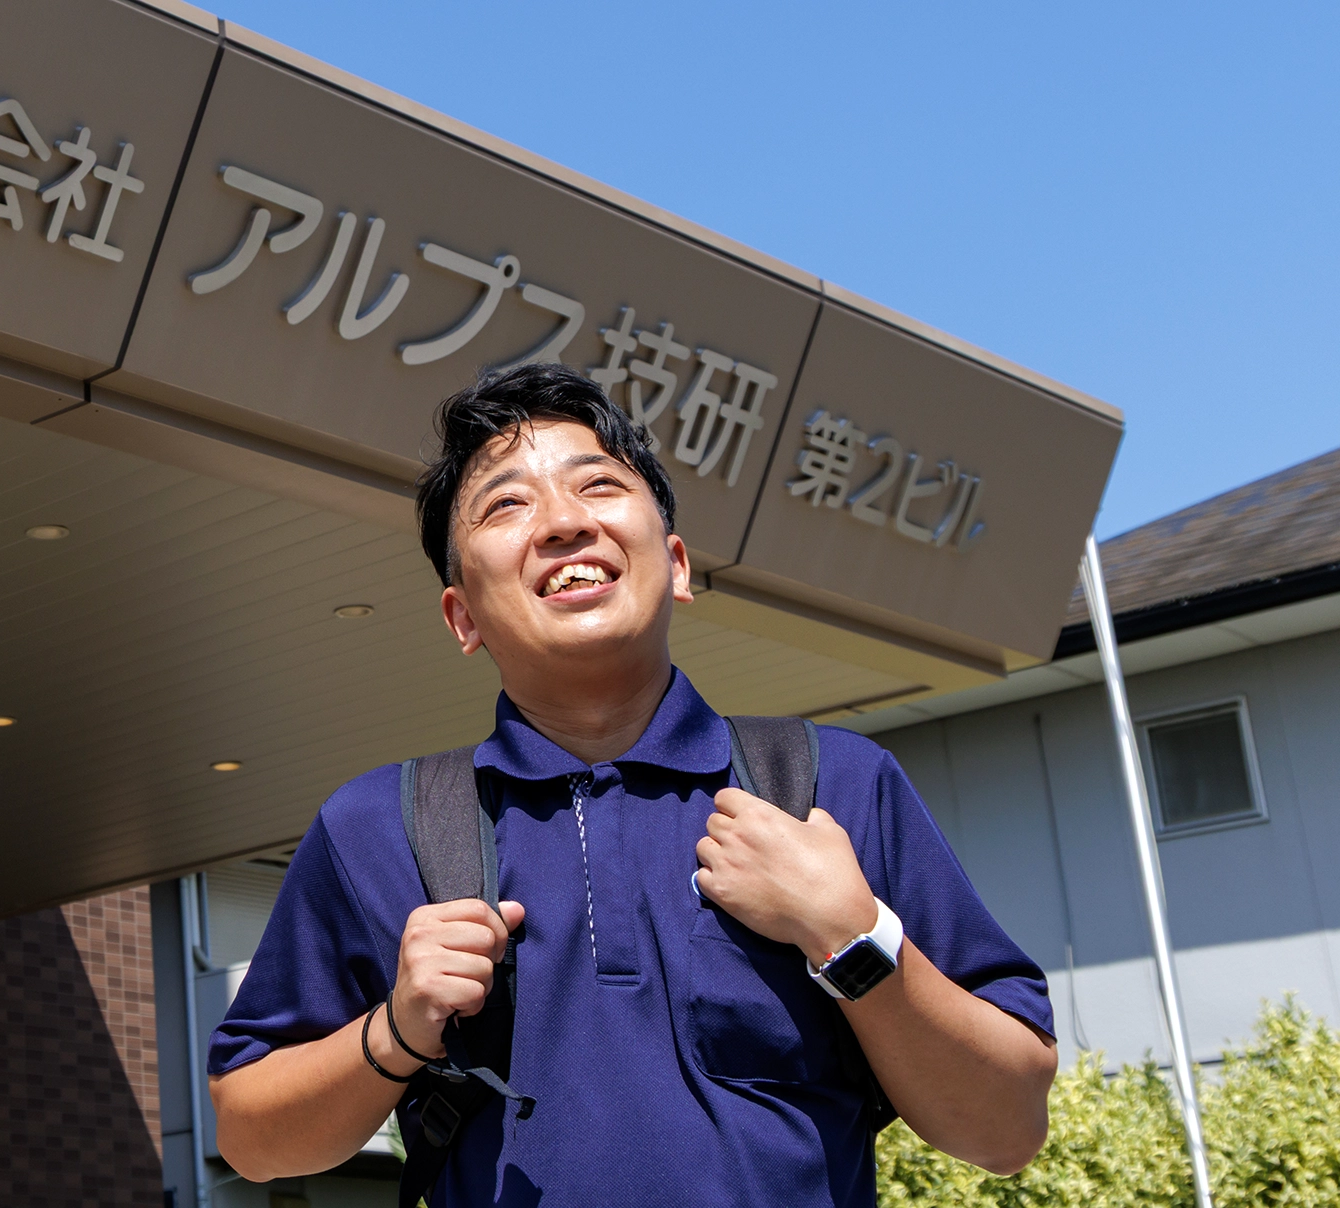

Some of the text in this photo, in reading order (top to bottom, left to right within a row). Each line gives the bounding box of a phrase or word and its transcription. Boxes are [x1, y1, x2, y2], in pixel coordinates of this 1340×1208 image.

[188, 165, 778, 487] アルプス技研
[787, 410, 984, 552] 第2ビル
